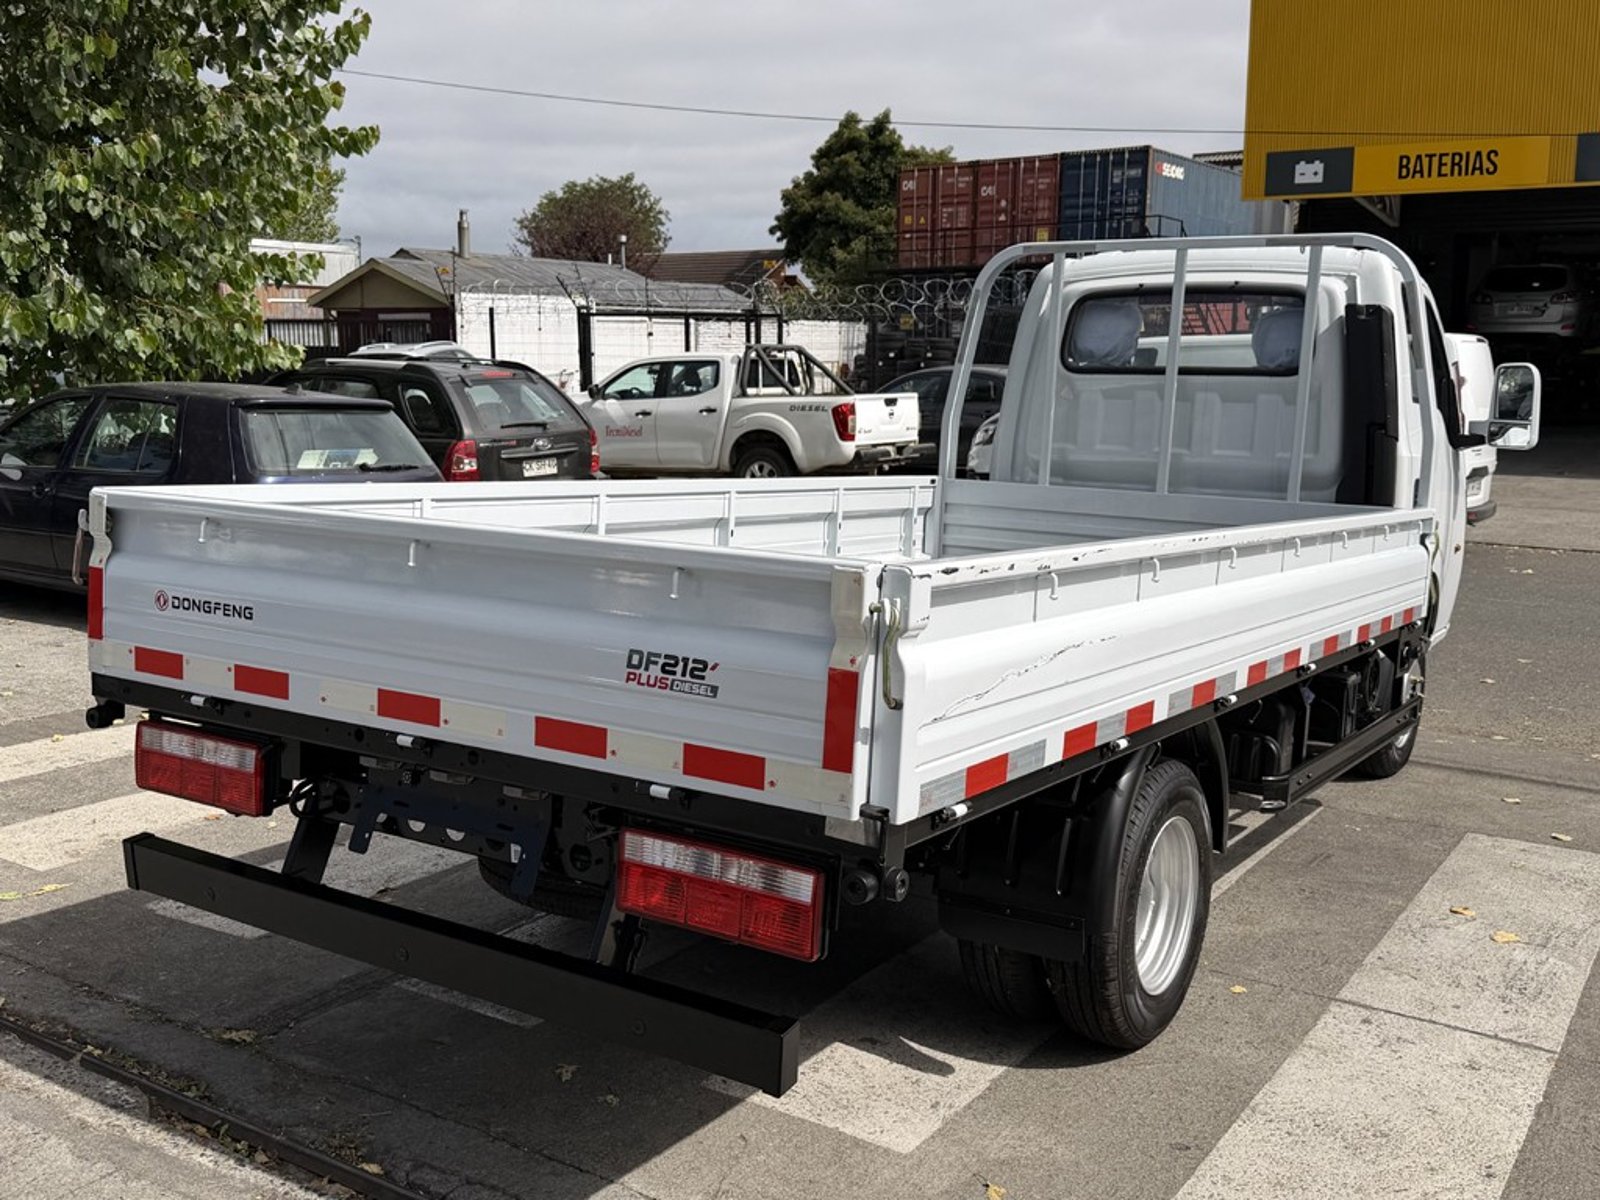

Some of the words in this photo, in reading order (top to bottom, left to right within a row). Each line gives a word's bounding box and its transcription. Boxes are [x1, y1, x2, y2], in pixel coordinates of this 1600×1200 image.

[1398, 149, 1499, 180] BATERIAS
[789, 404, 828, 412] DIESEL
[171, 596, 254, 620] DONGFENG
[625, 671, 669, 690] PLUS
[672, 680, 717, 697] DIESEL
